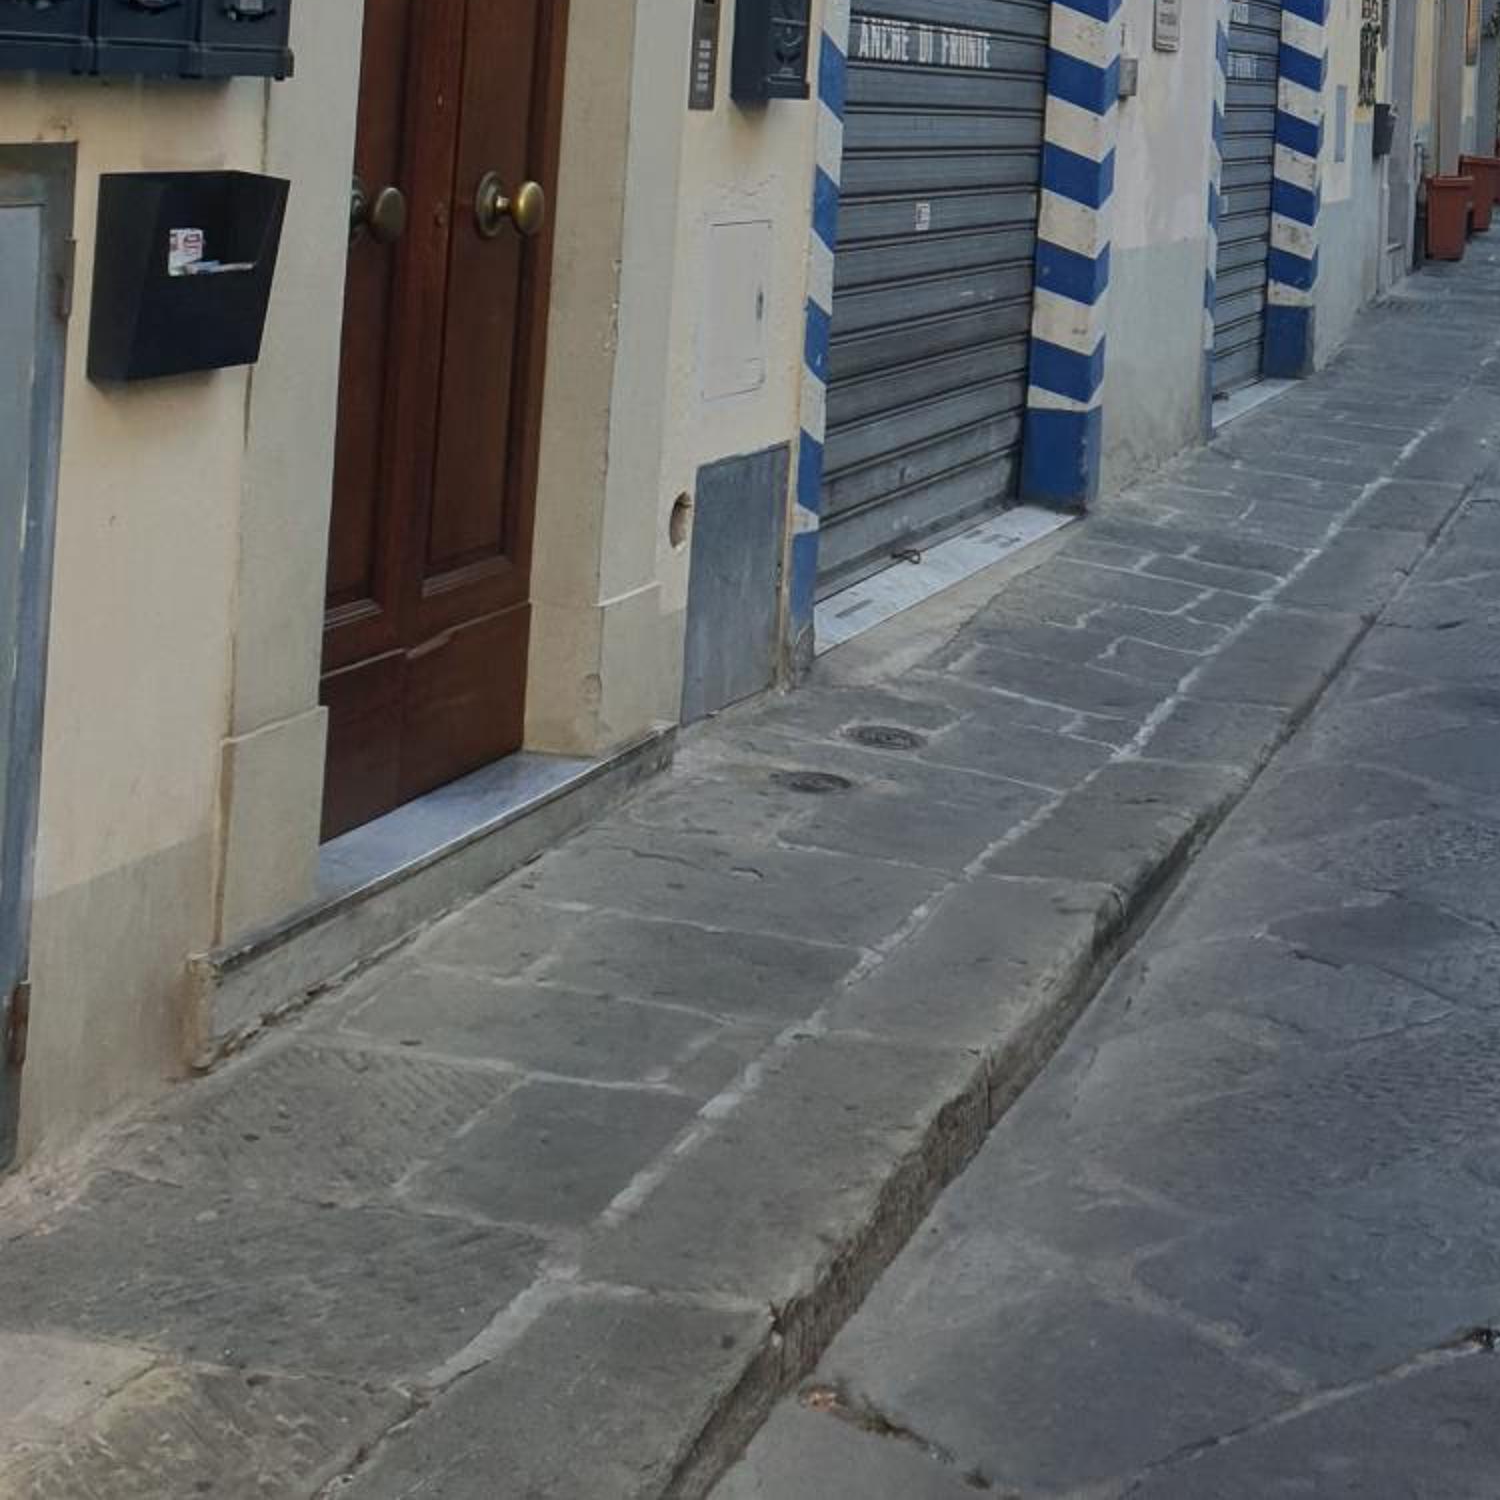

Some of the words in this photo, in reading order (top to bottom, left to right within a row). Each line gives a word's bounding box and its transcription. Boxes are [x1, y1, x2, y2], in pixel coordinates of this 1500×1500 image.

[858, 17, 910, 62] ANCHE
[919, 24, 933, 64] DI
[941, 28, 991, 68] FRONTE
